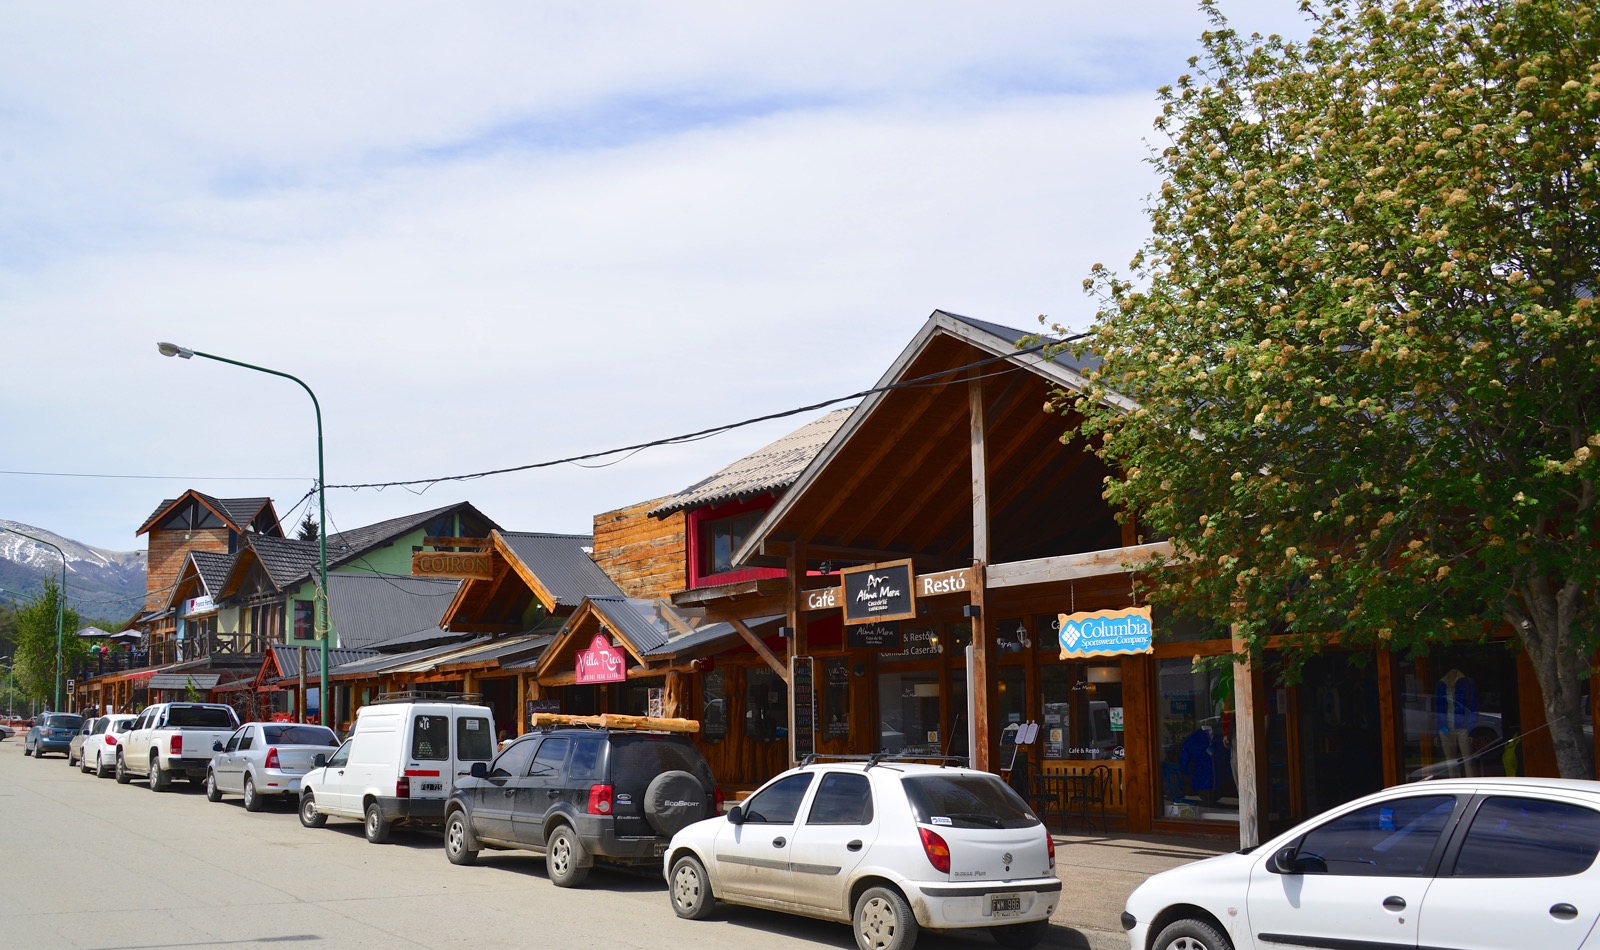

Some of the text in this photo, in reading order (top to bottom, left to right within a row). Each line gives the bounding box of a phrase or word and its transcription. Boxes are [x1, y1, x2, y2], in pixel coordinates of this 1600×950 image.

[420, 556, 489, 573] COIRON
[924, 573, 966, 595] Restó
[808, 590, 835, 609] Café
[856, 586, 900, 603] Alma Mora
[1080, 618, 1148, 639] Columbia
[910, 645, 938, 655] Caseras
[1081, 635, 1148, 649] Sportswear Company
[577, 650, 622, 673] Villa Rica
[1007, 899, 1021, 910] 986
